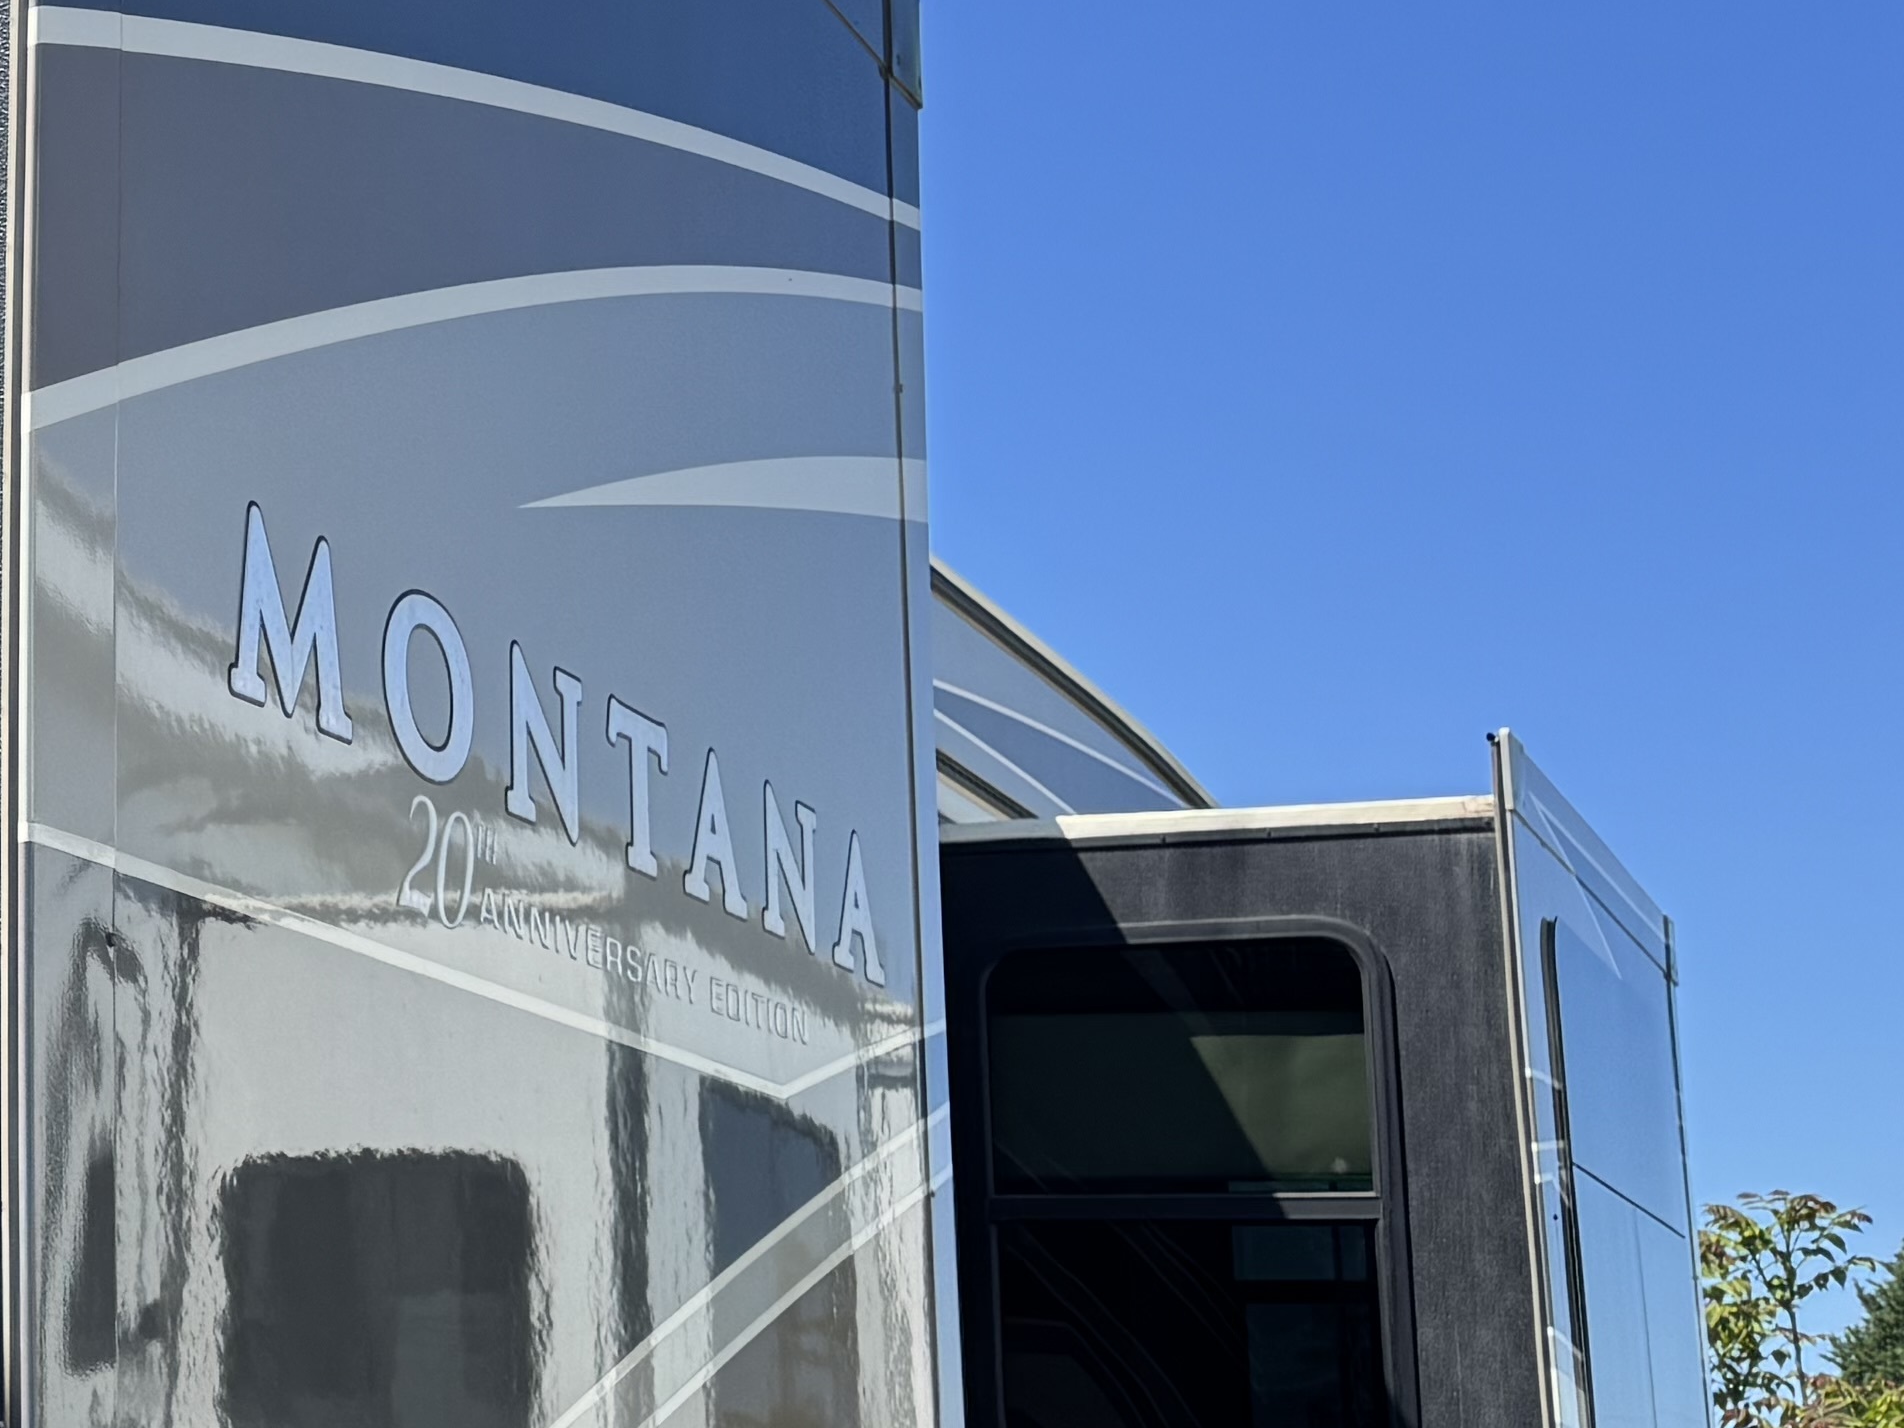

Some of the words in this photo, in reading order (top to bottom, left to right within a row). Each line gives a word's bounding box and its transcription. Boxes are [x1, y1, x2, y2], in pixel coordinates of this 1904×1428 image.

[228, 500, 885, 988] MONTANA
[479, 886, 697, 1004] ANNIVERSARY
[709, 976, 808, 1046] EDITION
